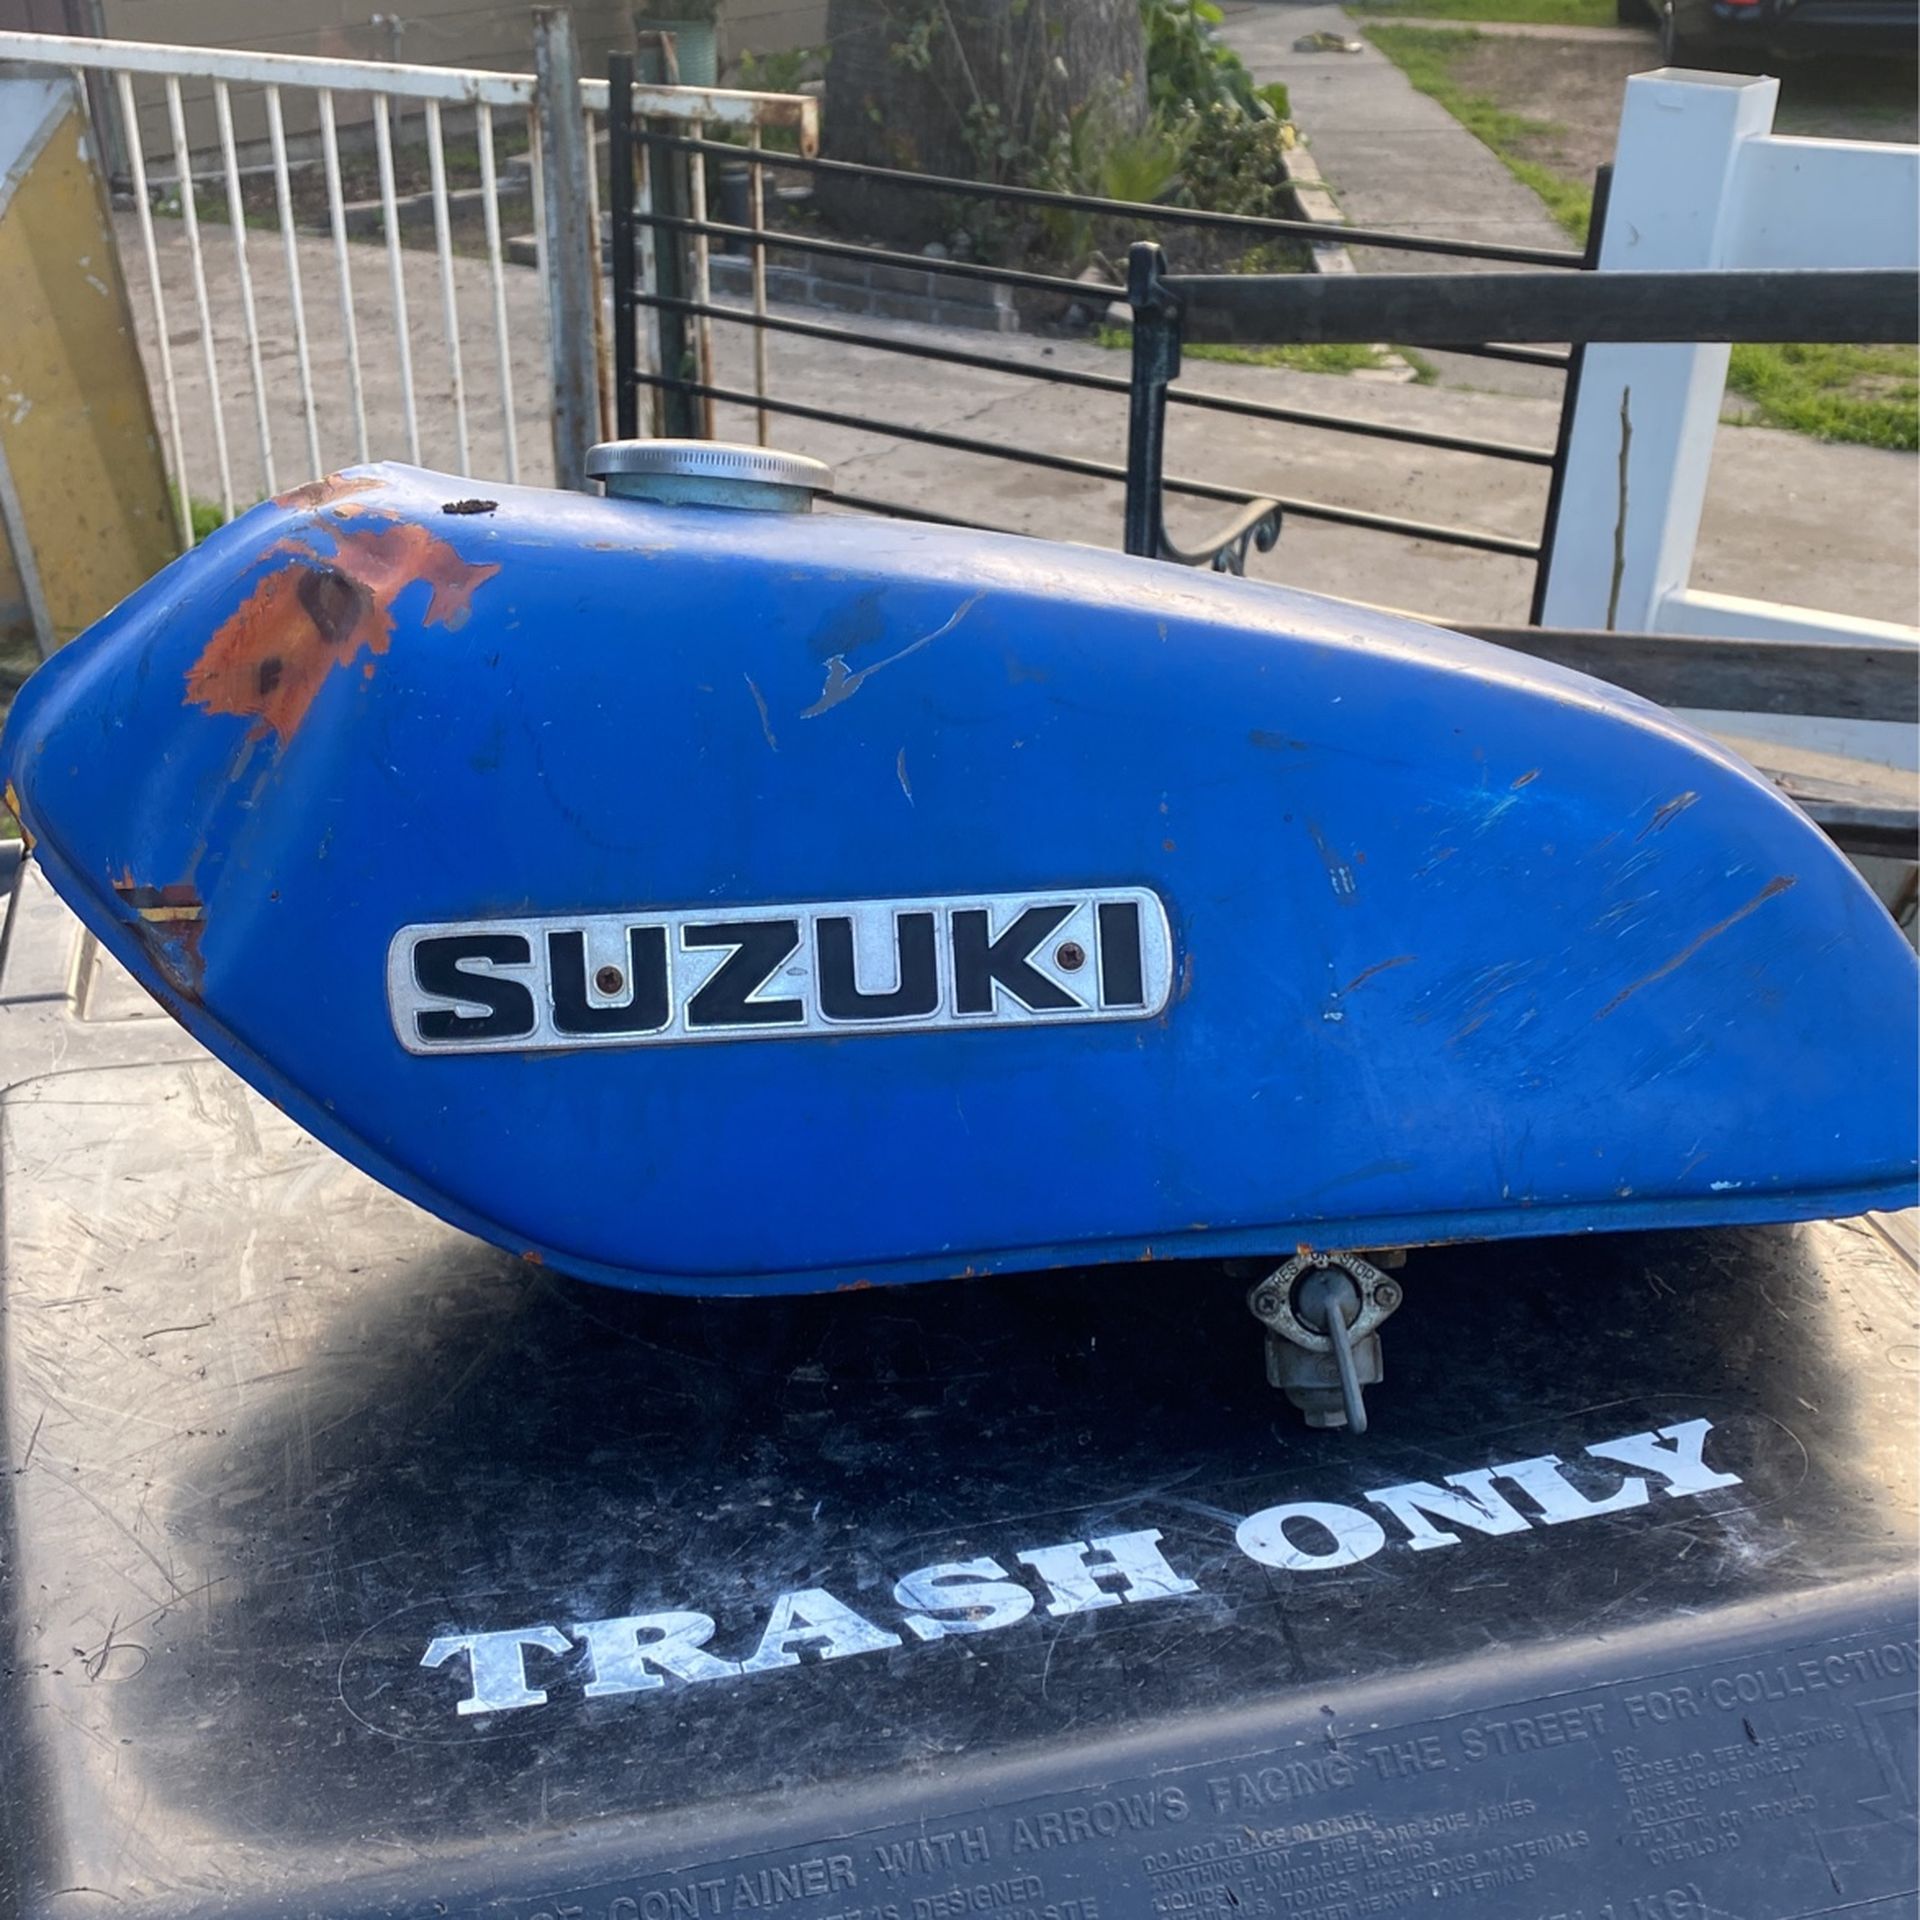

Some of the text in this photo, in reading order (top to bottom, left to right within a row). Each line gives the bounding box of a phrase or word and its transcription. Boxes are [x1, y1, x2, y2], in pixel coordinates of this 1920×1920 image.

[413, 902, 1147, 1038] SUZUKI
[1339, 1252, 1375, 1280] STOP
[420, 1418, 1743, 1716] TRASH ONLY
[608, 1854, 858, 1920] CONTAINER
[874, 1825, 991, 1880] WITH
[1011, 1786, 1190, 1854] ARROWS
[1206, 1754, 1355, 1814] FACING
[1364, 1731, 1447, 1780] THE
[1462, 1704, 1607, 1759] STREET
[1624, 1684, 1703, 1727] FOR
[1254, 1850, 1292, 1871] HOT
[1477, 1798, 1537, 1828] ASHES
[1650, 1832, 1742, 1867] OVERLOAD
[1142, 1853, 1171, 1873] DO
[1175, 1842, 1217, 1863] NOT
[1240, 1856, 1358, 1895] FLAMMABLE
[911, 1875, 1046, 1920] DESIGNED
